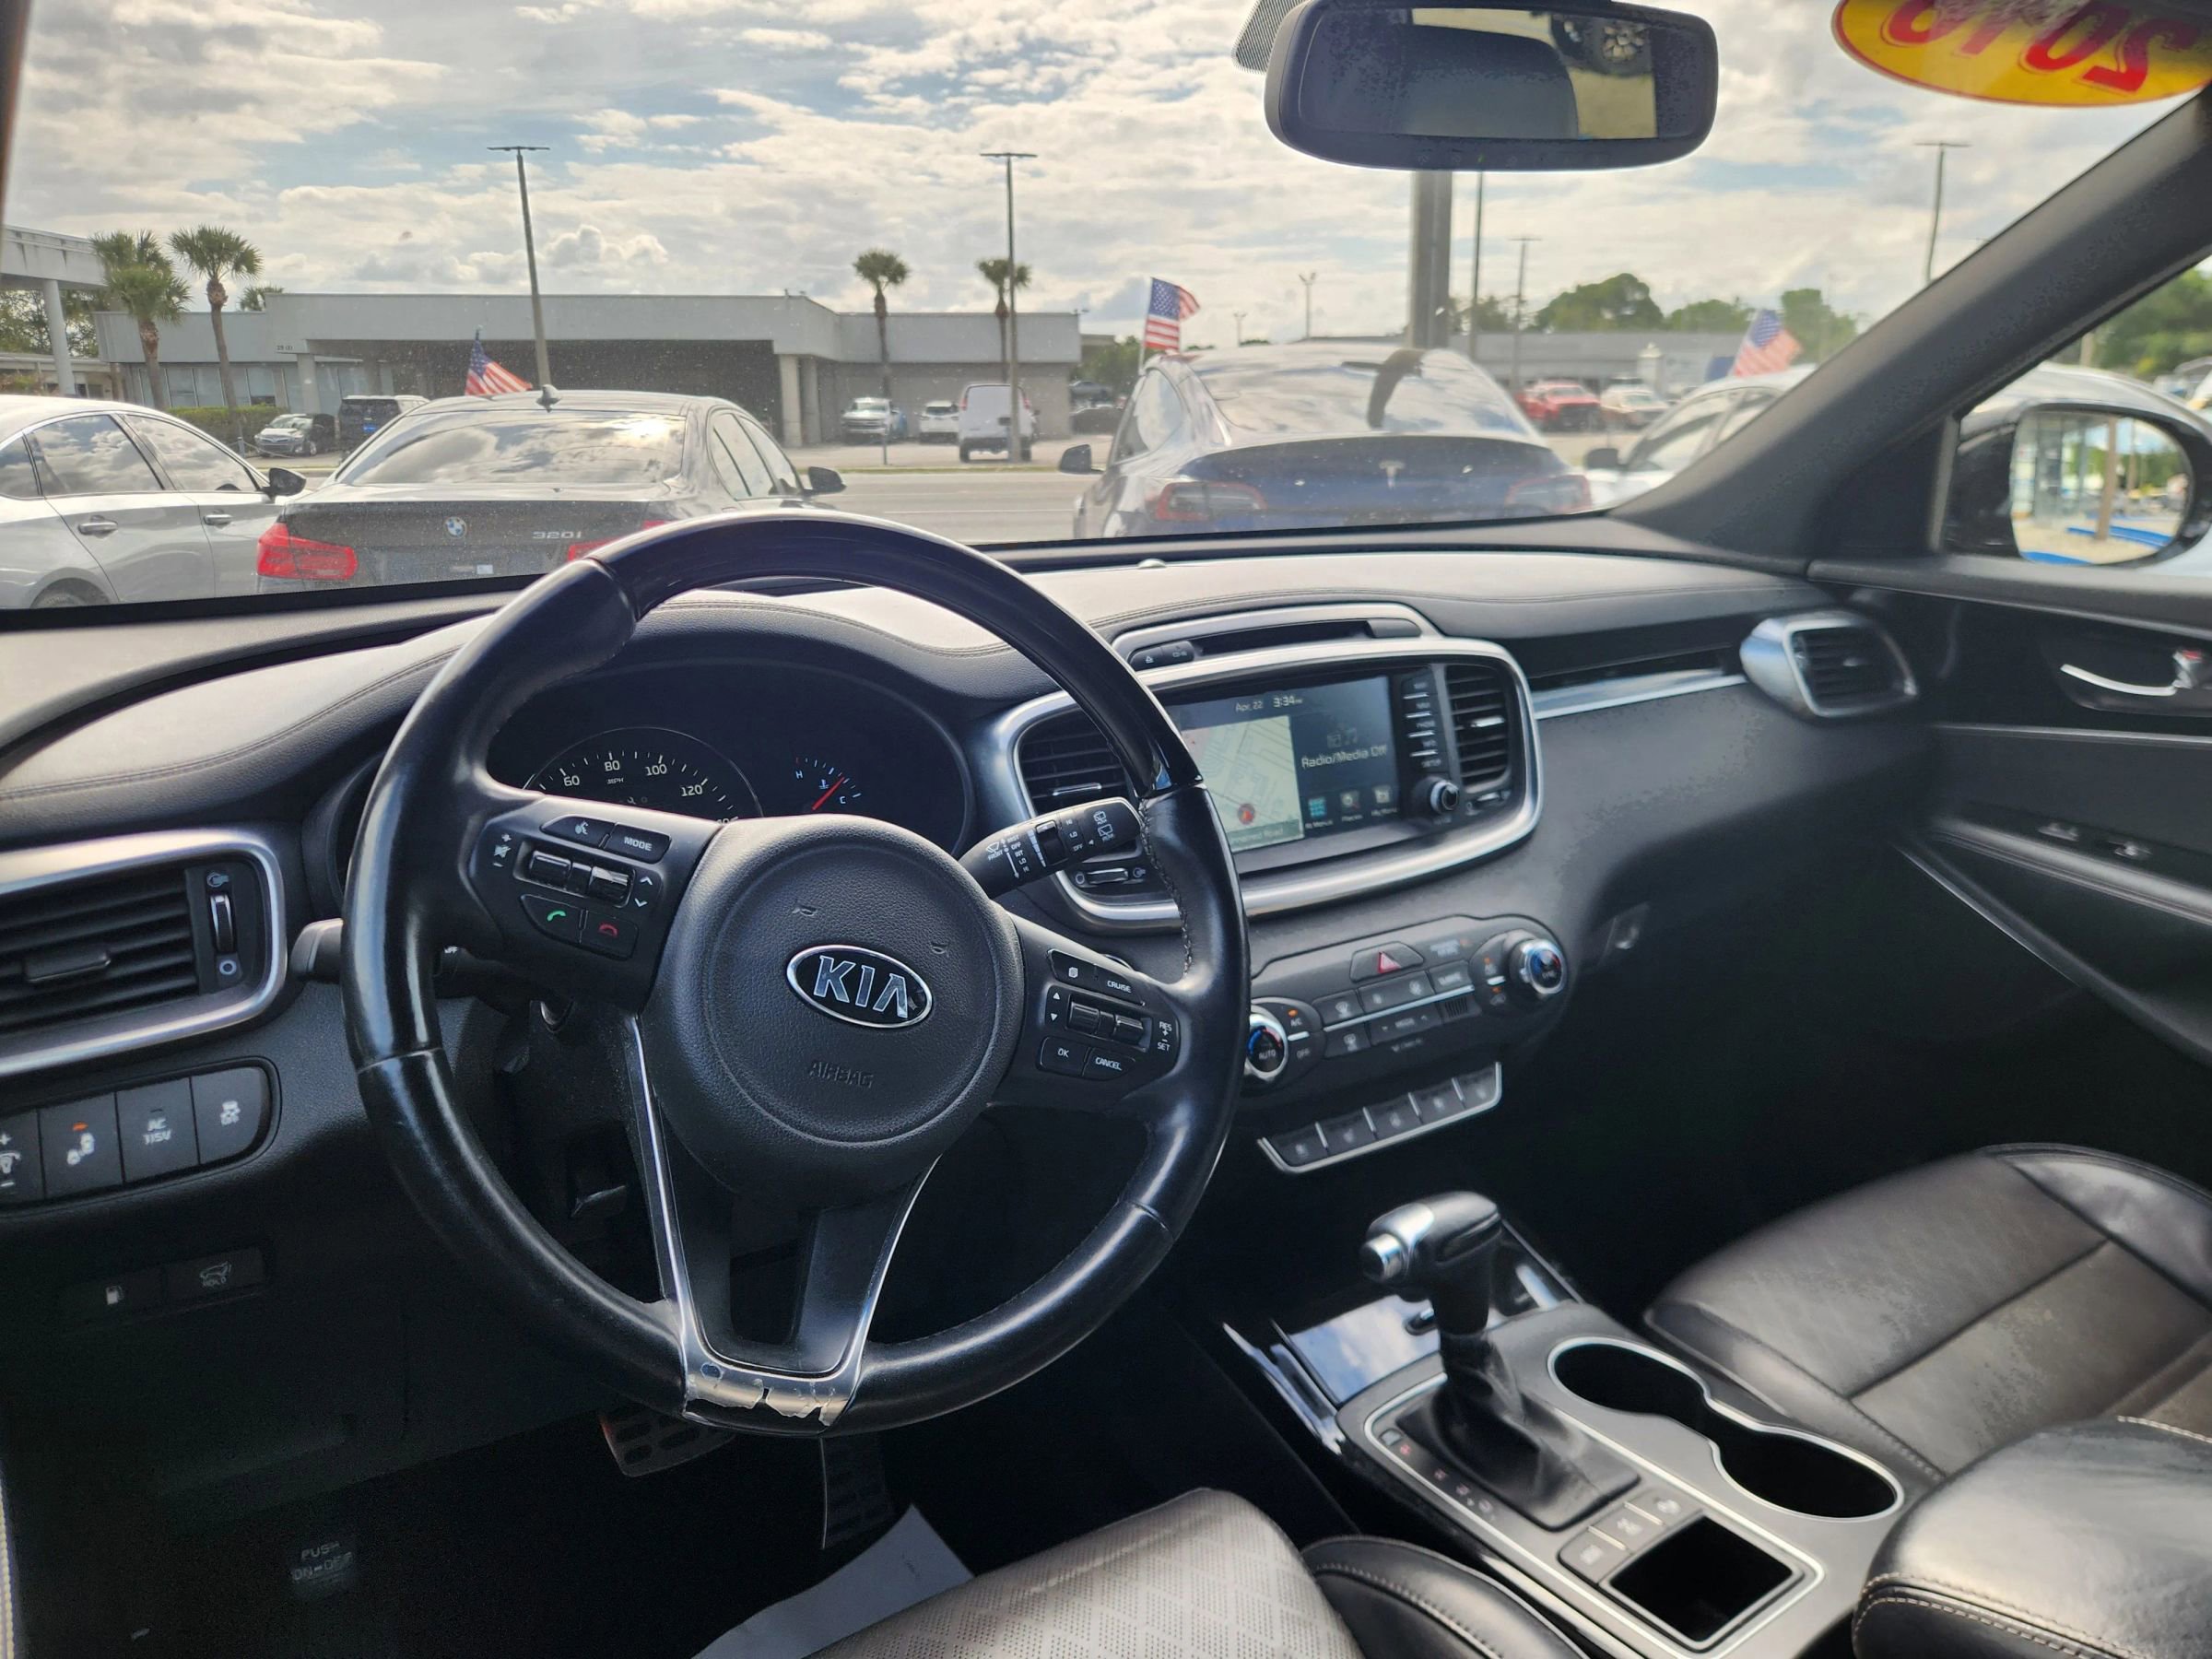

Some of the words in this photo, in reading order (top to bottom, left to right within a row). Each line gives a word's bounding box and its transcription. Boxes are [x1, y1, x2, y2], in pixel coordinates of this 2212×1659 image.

[1273, 696, 1295, 708] 3:34
[1301, 748, 1369, 769] Radio/Media
[1371, 746, 1387, 758] Off
[605, 759, 620, 772] 80
[644, 763, 667, 776] 100
[563, 775, 580, 787] 60
[681, 783, 703, 796] 120
[623, 835, 653, 852] MODE
[1011, 841, 1021, 851] OFF
[814, 955, 909, 1018] KIA
[1107, 980, 1132, 994] CRUISE
[1159, 1020, 1172, 1032] RES
[1057, 1047, 1069, 1058] OK
[1157, 1041, 1171, 1052] SET
[1258, 1049, 1277, 1060] AUTO
[1095, 1055, 1123, 1071] CANCEL
[147, 1117, 167, 1132] AC
